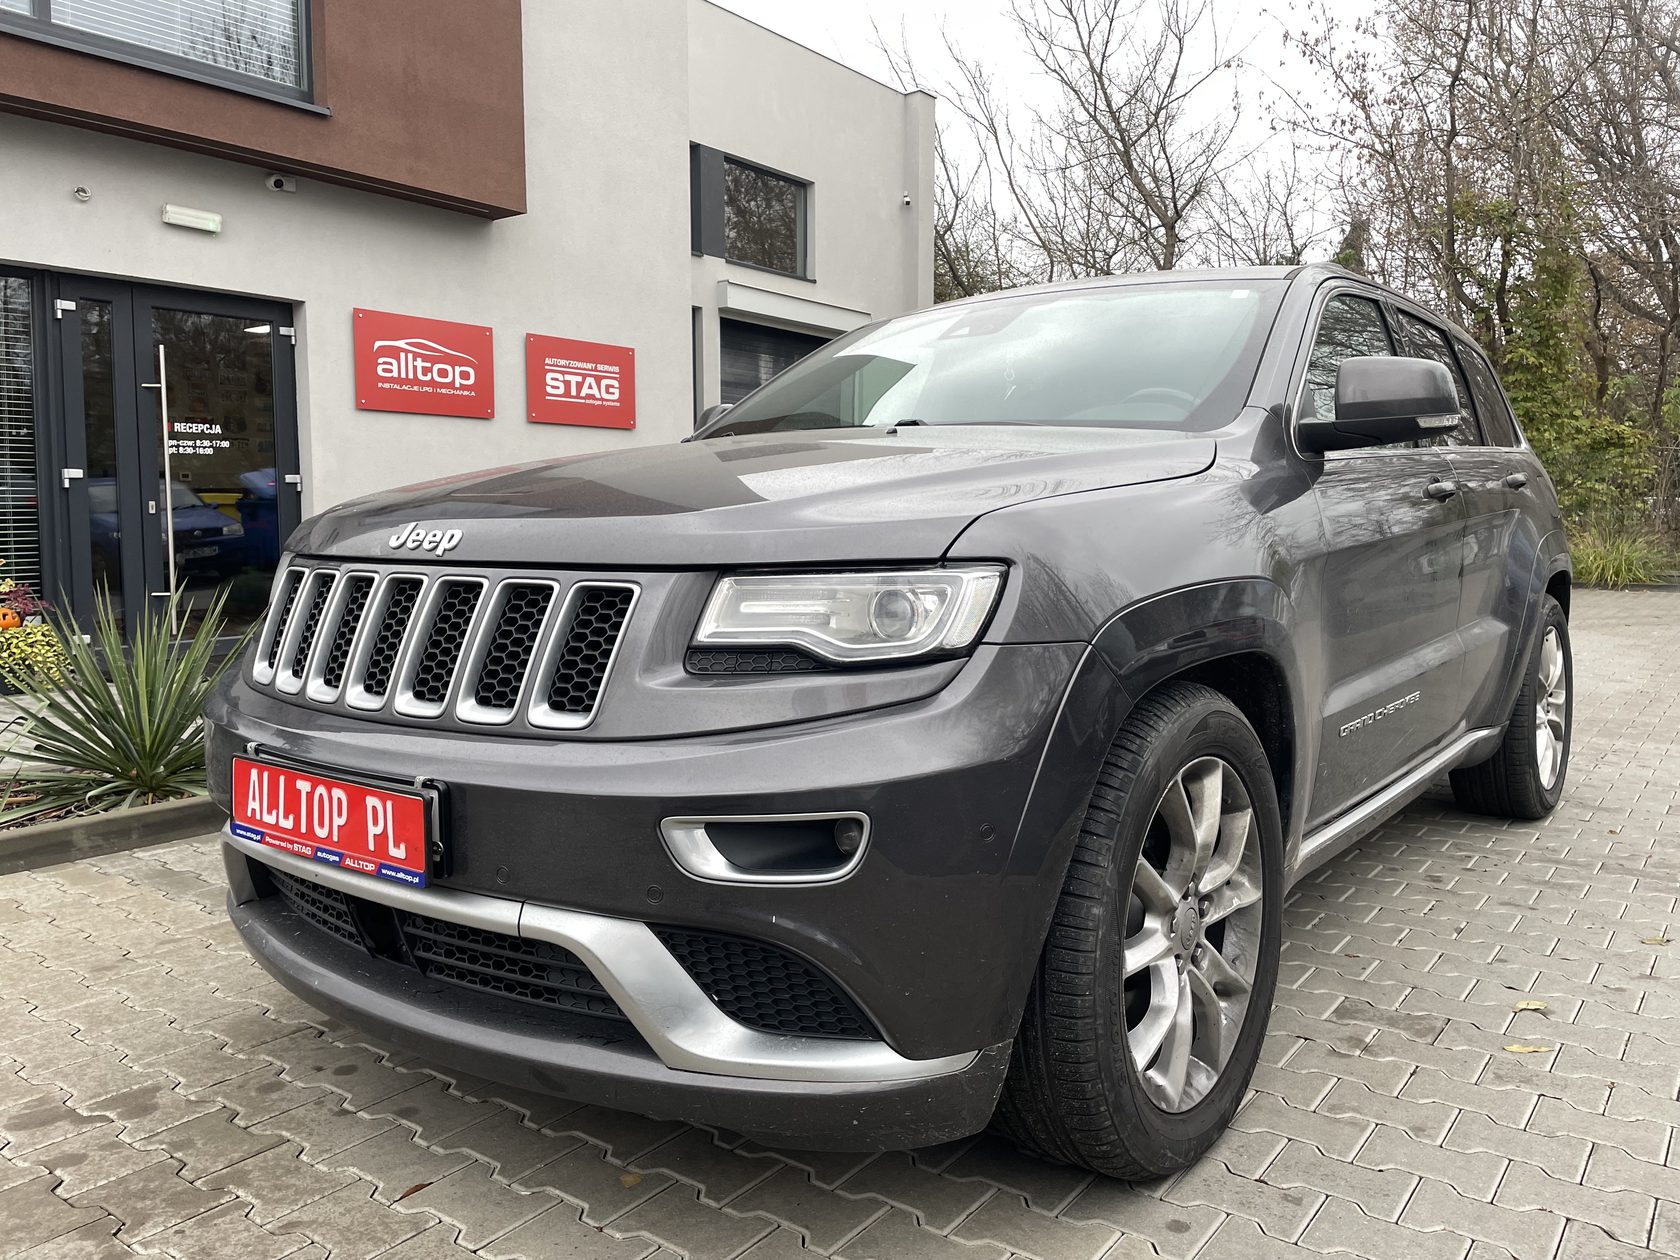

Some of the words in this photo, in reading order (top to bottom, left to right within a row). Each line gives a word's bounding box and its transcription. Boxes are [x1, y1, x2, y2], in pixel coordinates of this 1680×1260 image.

[376, 352, 475, 387] alltop
[545, 357, 596, 370] AUTORYZOWANY
[597, 364, 619, 373] SERWIS
[378, 382, 420, 392] INSTALACJE
[437, 387, 476, 396] MECHANIKA
[545, 372, 620, 400] STAG
[174, 422, 222, 434] RECEPCJA
[196, 440, 230, 448] 8:30-17:00
[388, 521, 463, 557] Jeep
[247, 768, 348, 842] ALLTOP
[365, 795, 406, 860] PL
[235, 828, 261, 841] www.stag.pl
[265, 836, 287, 848] Powered
[286, 841, 294, 850] by
[293, 843, 312, 855] STAG
[317, 850, 340, 862] autogas
[345, 857, 376, 871] ALLTOP
[381, 867, 420, 883] www.alltop.pl
